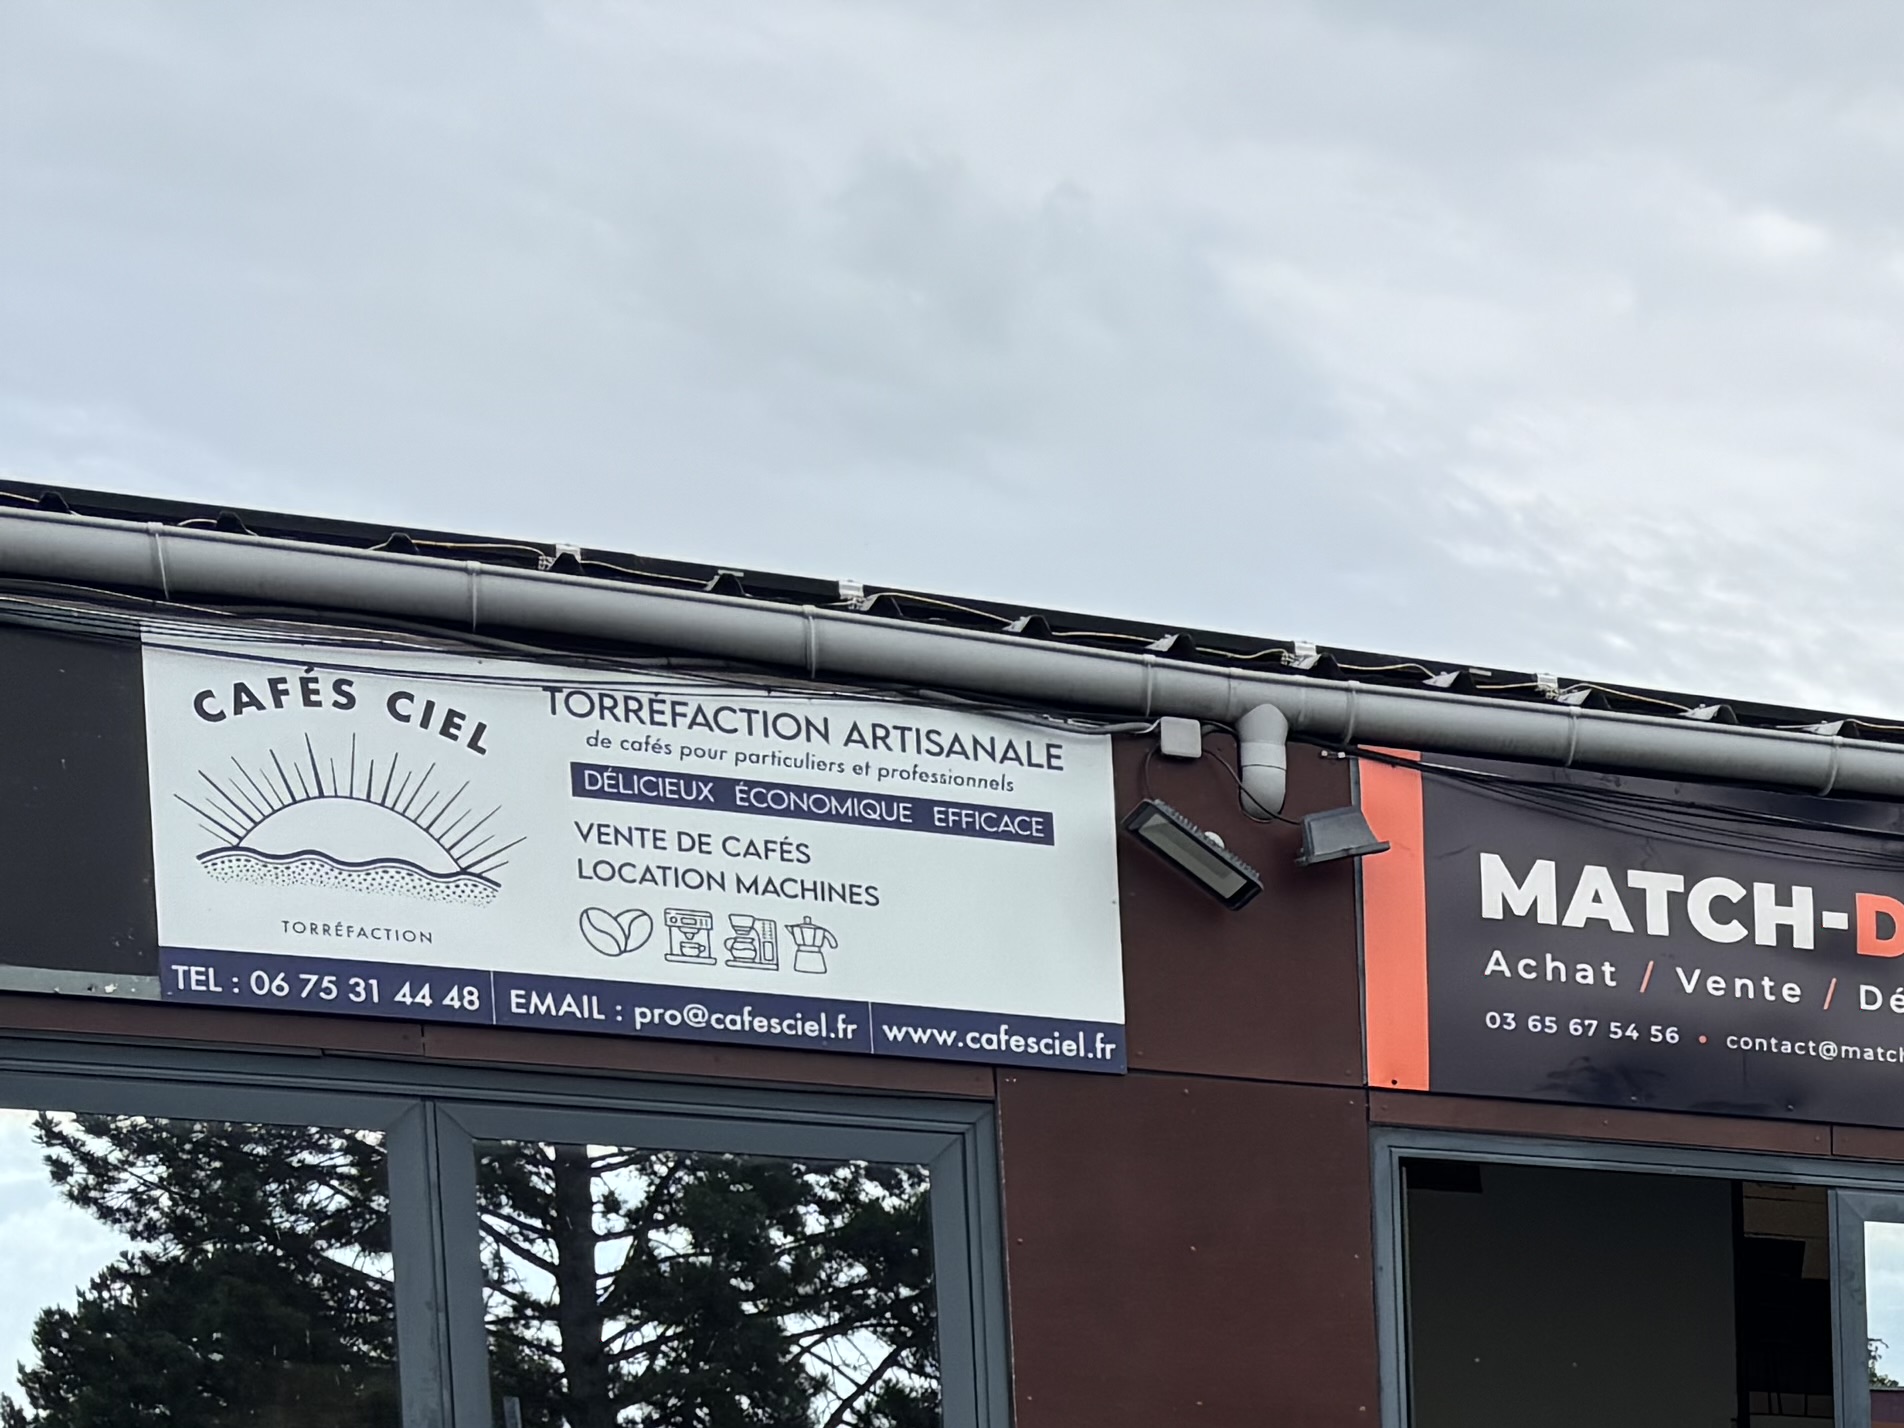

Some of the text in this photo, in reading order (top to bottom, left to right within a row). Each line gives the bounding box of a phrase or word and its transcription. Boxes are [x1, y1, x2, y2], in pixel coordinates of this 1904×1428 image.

[192, 666, 490, 757] CAFÉS CIEL
[542, 686, 1065, 772] TORRÉFACTION ARTISANALE
[586, 729, 1015, 792] de cafés pour particuliers et professionnels
[584, 767, 1045, 837] DÉLICIEUX ÉCONOMIQUE EFFICACE
[574, 820, 811, 864] VENTE DE CAFÉS
[577, 858, 880, 907] LOCATION MACHINES
[281, 919, 434, 945] TORRÉFACTION
[250, 969, 290, 997] 06
[299, 973, 338, 1000] 75
[348, 976, 380, 1004] 31
[394, 979, 432, 1007] 44
[442, 984, 481, 1011] 48
[1484, 949, 1617, 988] Achat
[1639, 960, 1655, 993] /
[1675, 966, 1802, 1004] Vente
[1823, 977, 1837, 1011] /
[634, 1003, 858, 1041] pro@cafesciel.fr
[882, 1020, 1117, 1062] www.cafesciel.fr
[1485, 1011, 1517, 1031] 03
[1527, 1014, 1558, 1034] 65
[1568, 1018, 1598, 1038] 67
[1608, 1022, 1640, 1041] 54
[1649, 1025, 1681, 1044] 56
